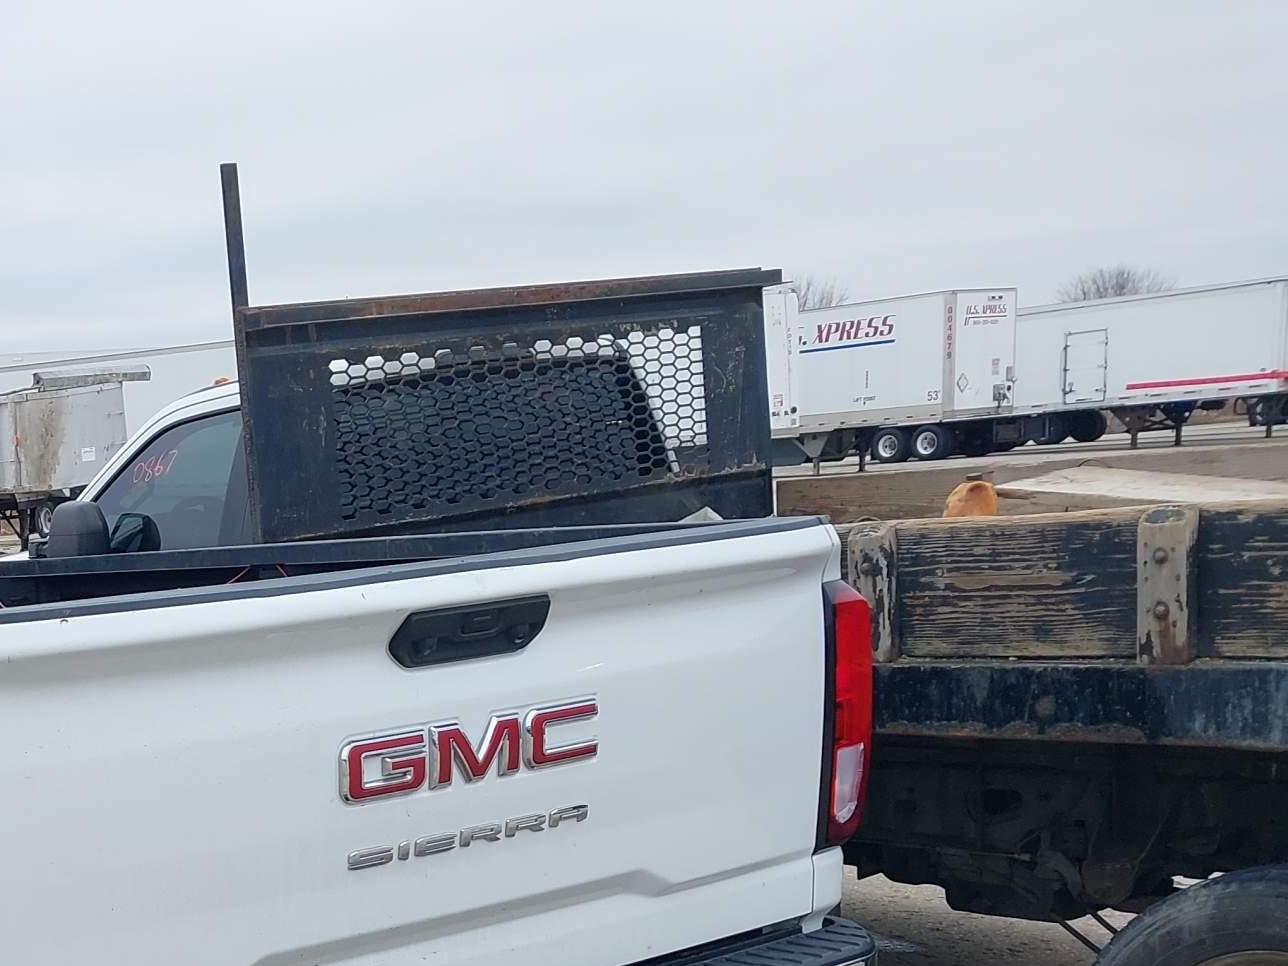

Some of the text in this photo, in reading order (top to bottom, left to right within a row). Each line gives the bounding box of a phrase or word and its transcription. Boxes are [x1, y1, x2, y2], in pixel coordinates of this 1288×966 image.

[812, 314, 897, 345] XPRESS
[133, 449, 178, 483] 0867
[339, 698, 598, 804] GMC
[347, 804, 589, 871] SIERRA
